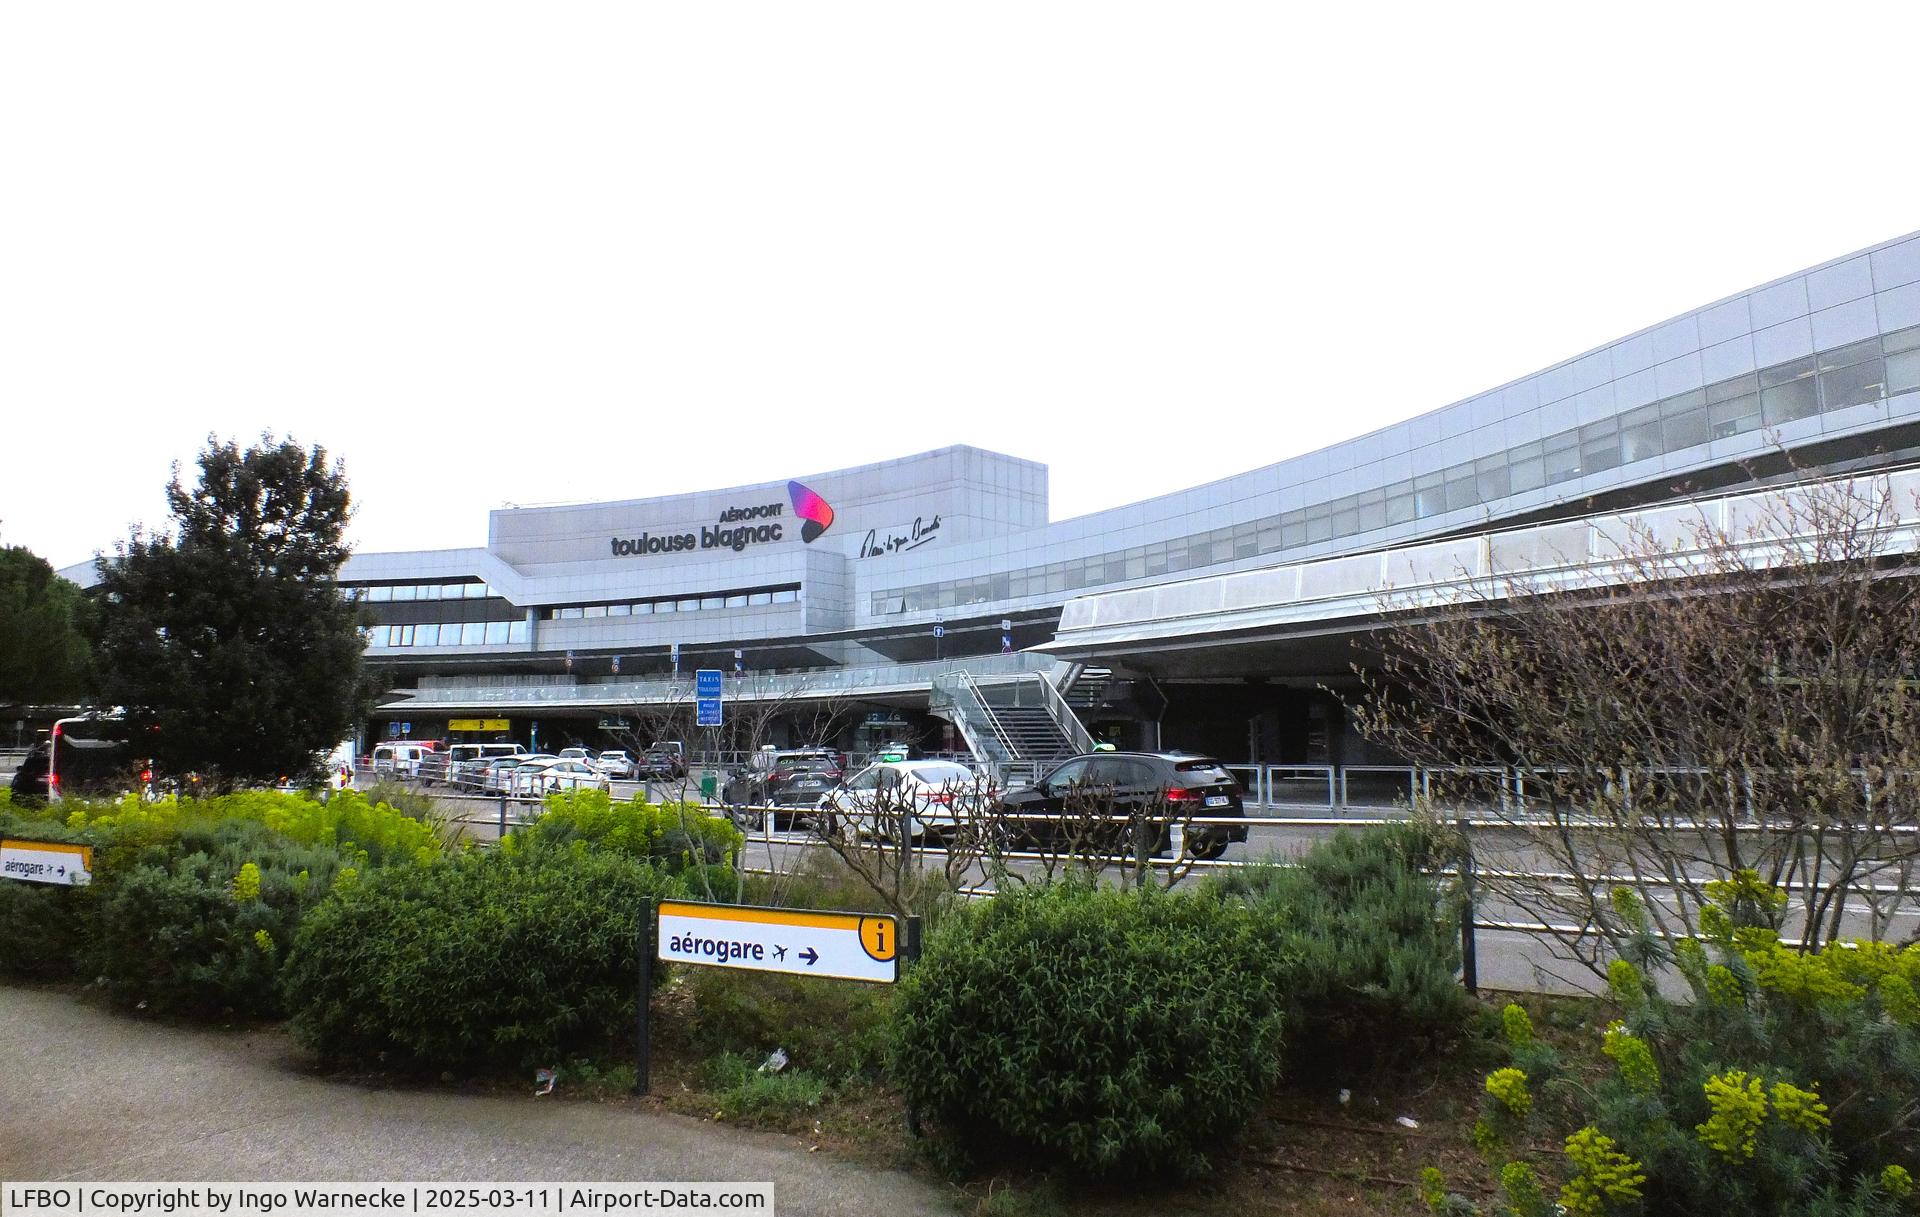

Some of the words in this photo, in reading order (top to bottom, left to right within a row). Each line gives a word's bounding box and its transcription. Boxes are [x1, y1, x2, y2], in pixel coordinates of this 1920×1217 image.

[719, 503, 784, 523] AÉROPORT
[611, 532, 696, 556] toulouse
[701, 523, 783, 551] blagnac
[5, 858, 44, 877] aérogare
[669, 931, 764, 963] aérogare
